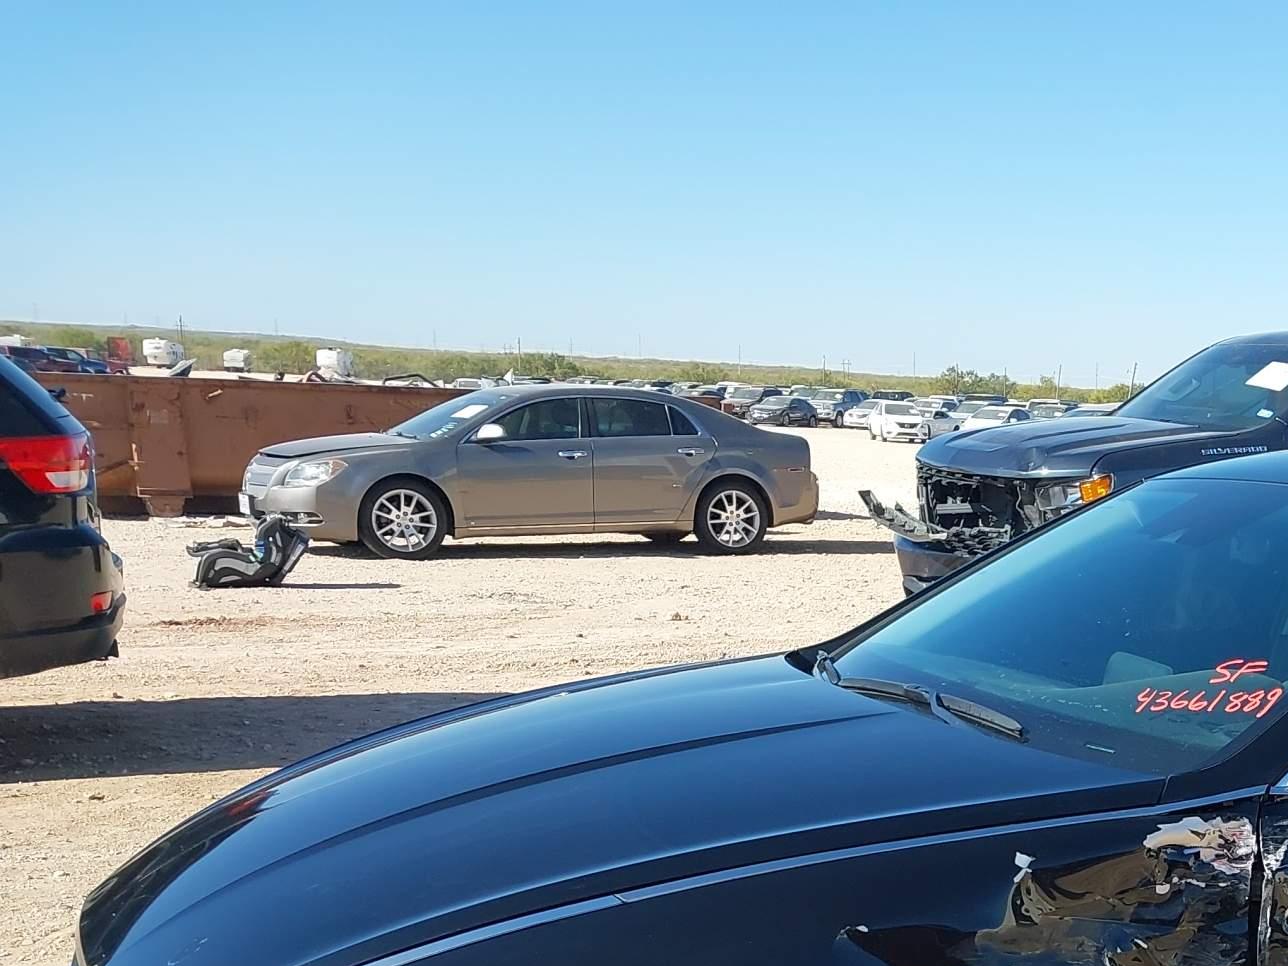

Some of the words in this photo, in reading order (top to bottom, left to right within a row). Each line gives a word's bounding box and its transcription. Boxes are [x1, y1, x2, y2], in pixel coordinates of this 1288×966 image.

[1201, 445, 1268, 456] SILVERADO
[1209, 659, 1268, 684] SF
[1135, 687, 1283, 718] 43661889
